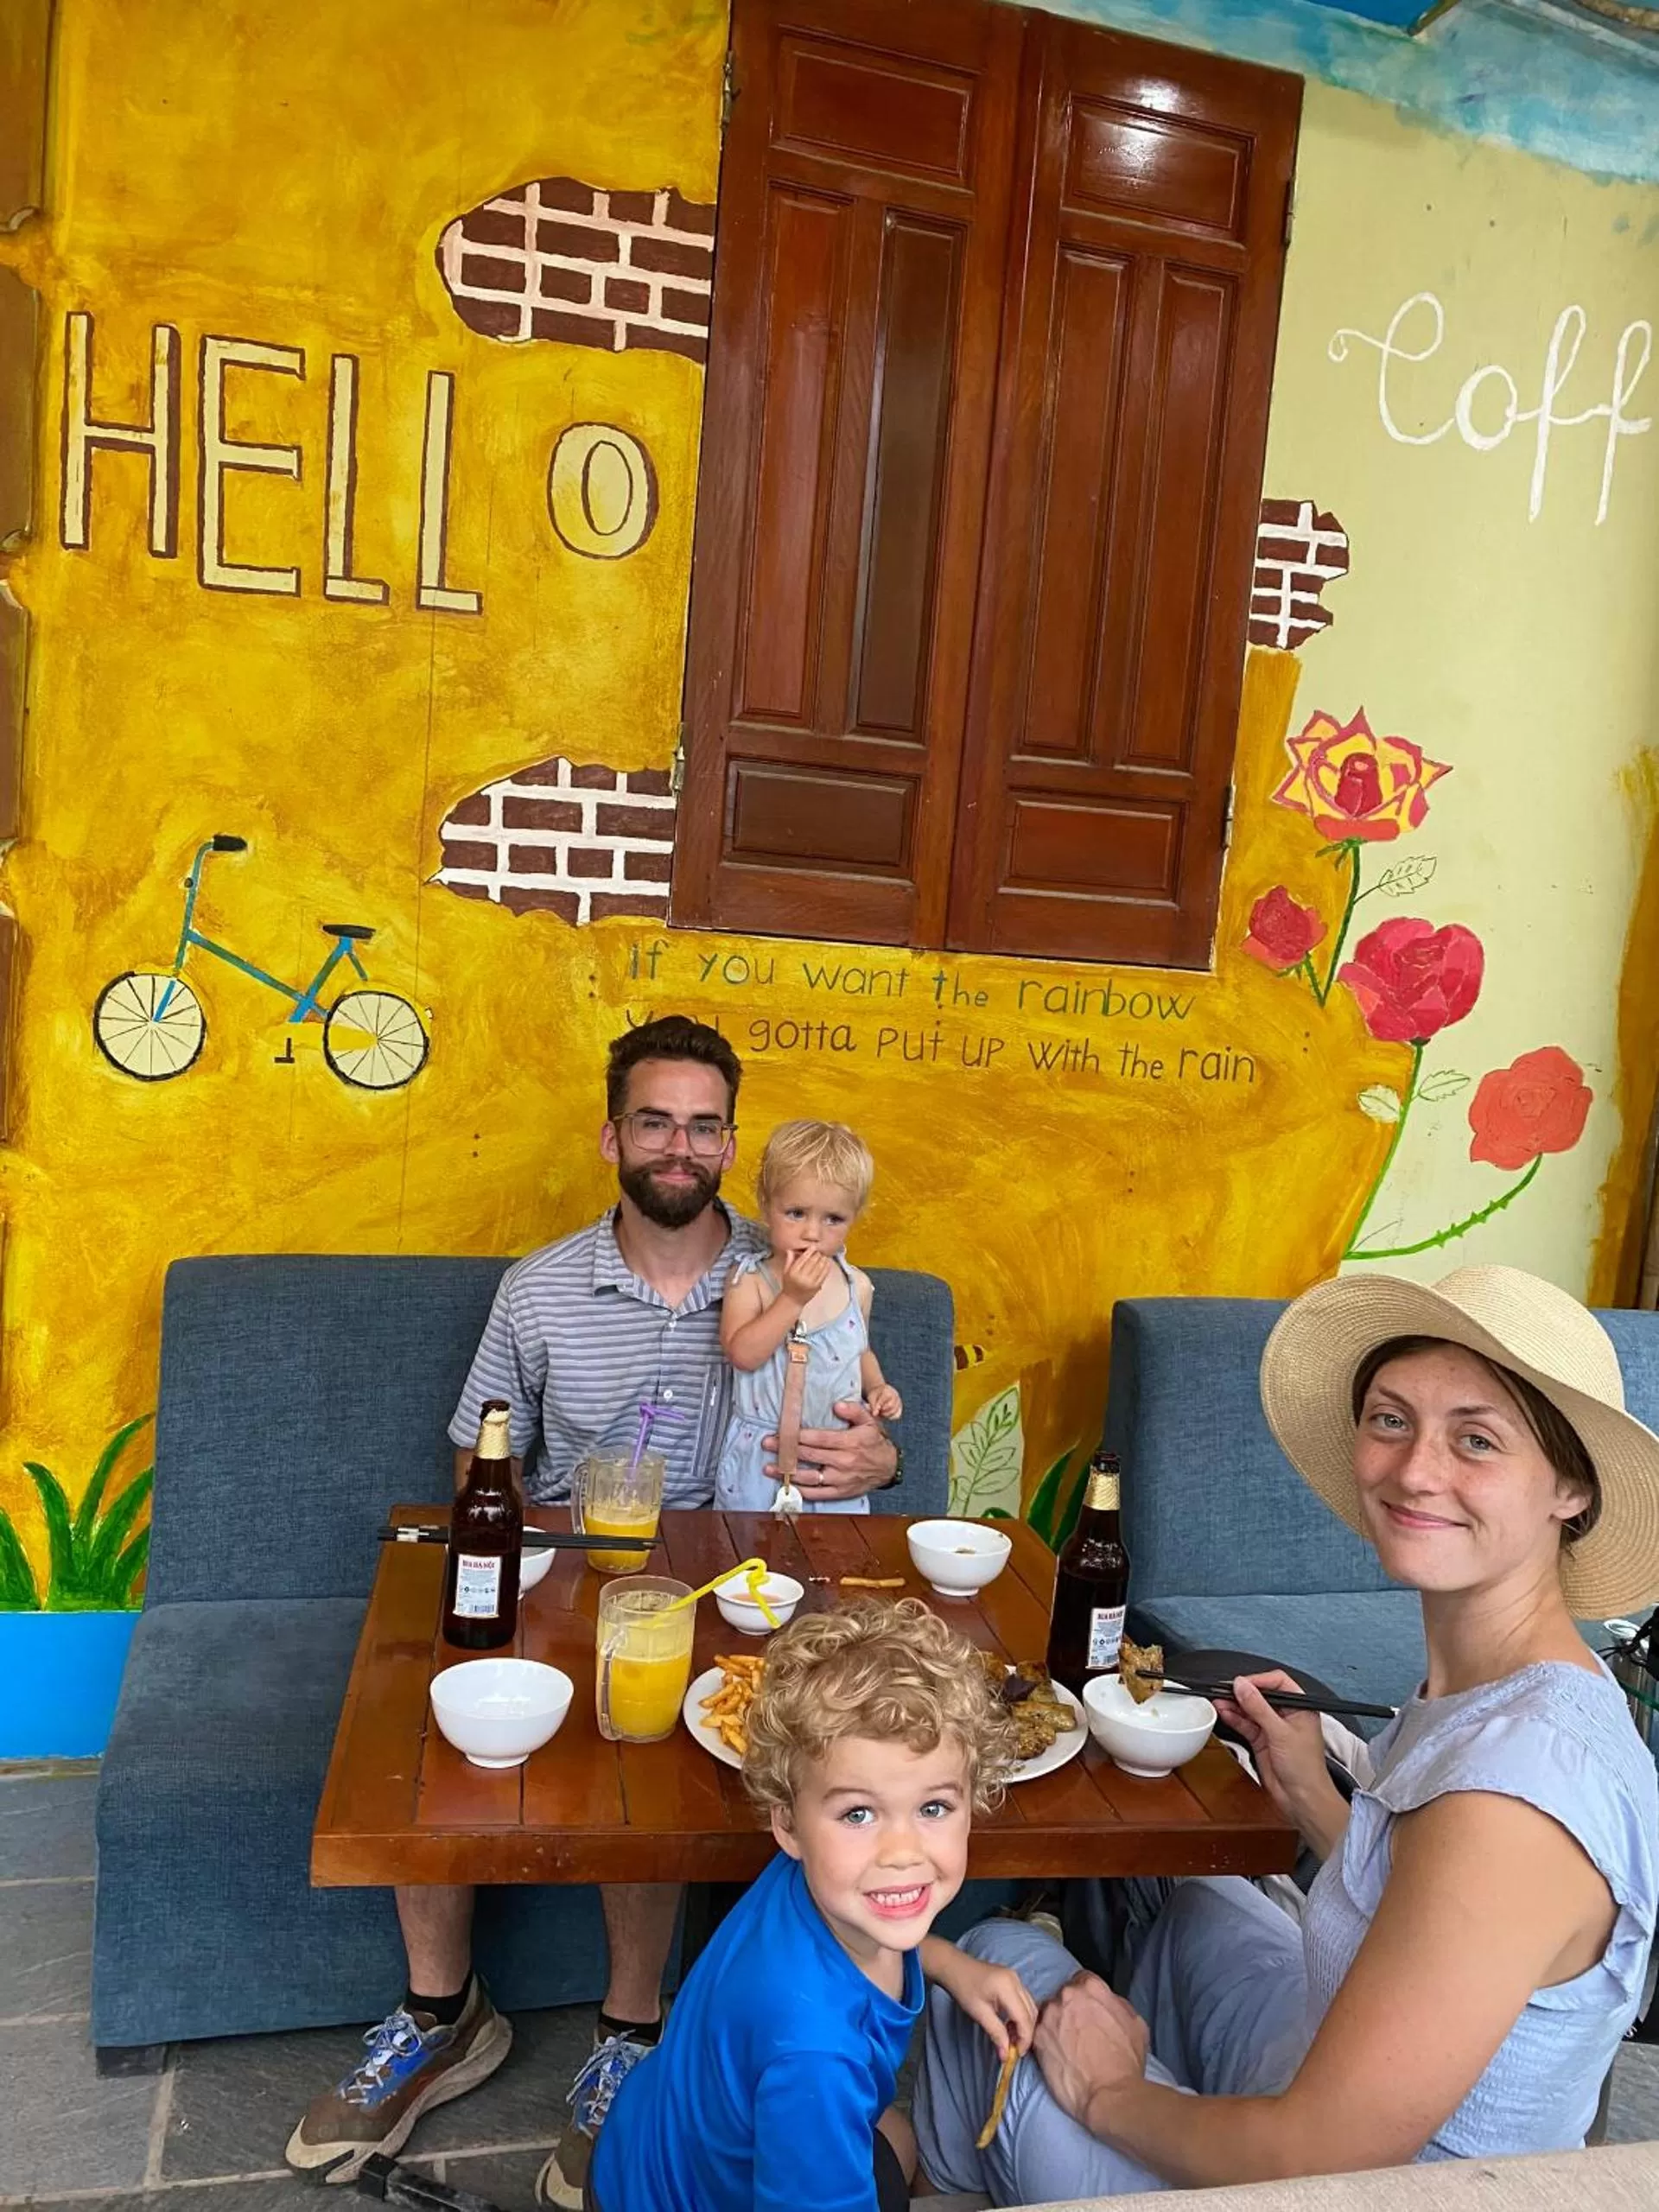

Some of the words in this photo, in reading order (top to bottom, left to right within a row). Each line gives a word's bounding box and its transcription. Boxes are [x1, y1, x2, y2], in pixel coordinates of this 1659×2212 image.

[697, 953, 775, 984] you
[803, 963, 911, 997] want
[931, 969, 989, 1007] the
[1018, 978, 1197, 1020] rainbow
[748, 1020, 858, 1052] gotta
[1118, 1041, 1164, 1080] the
[1178, 1046, 1255, 1083] rain
